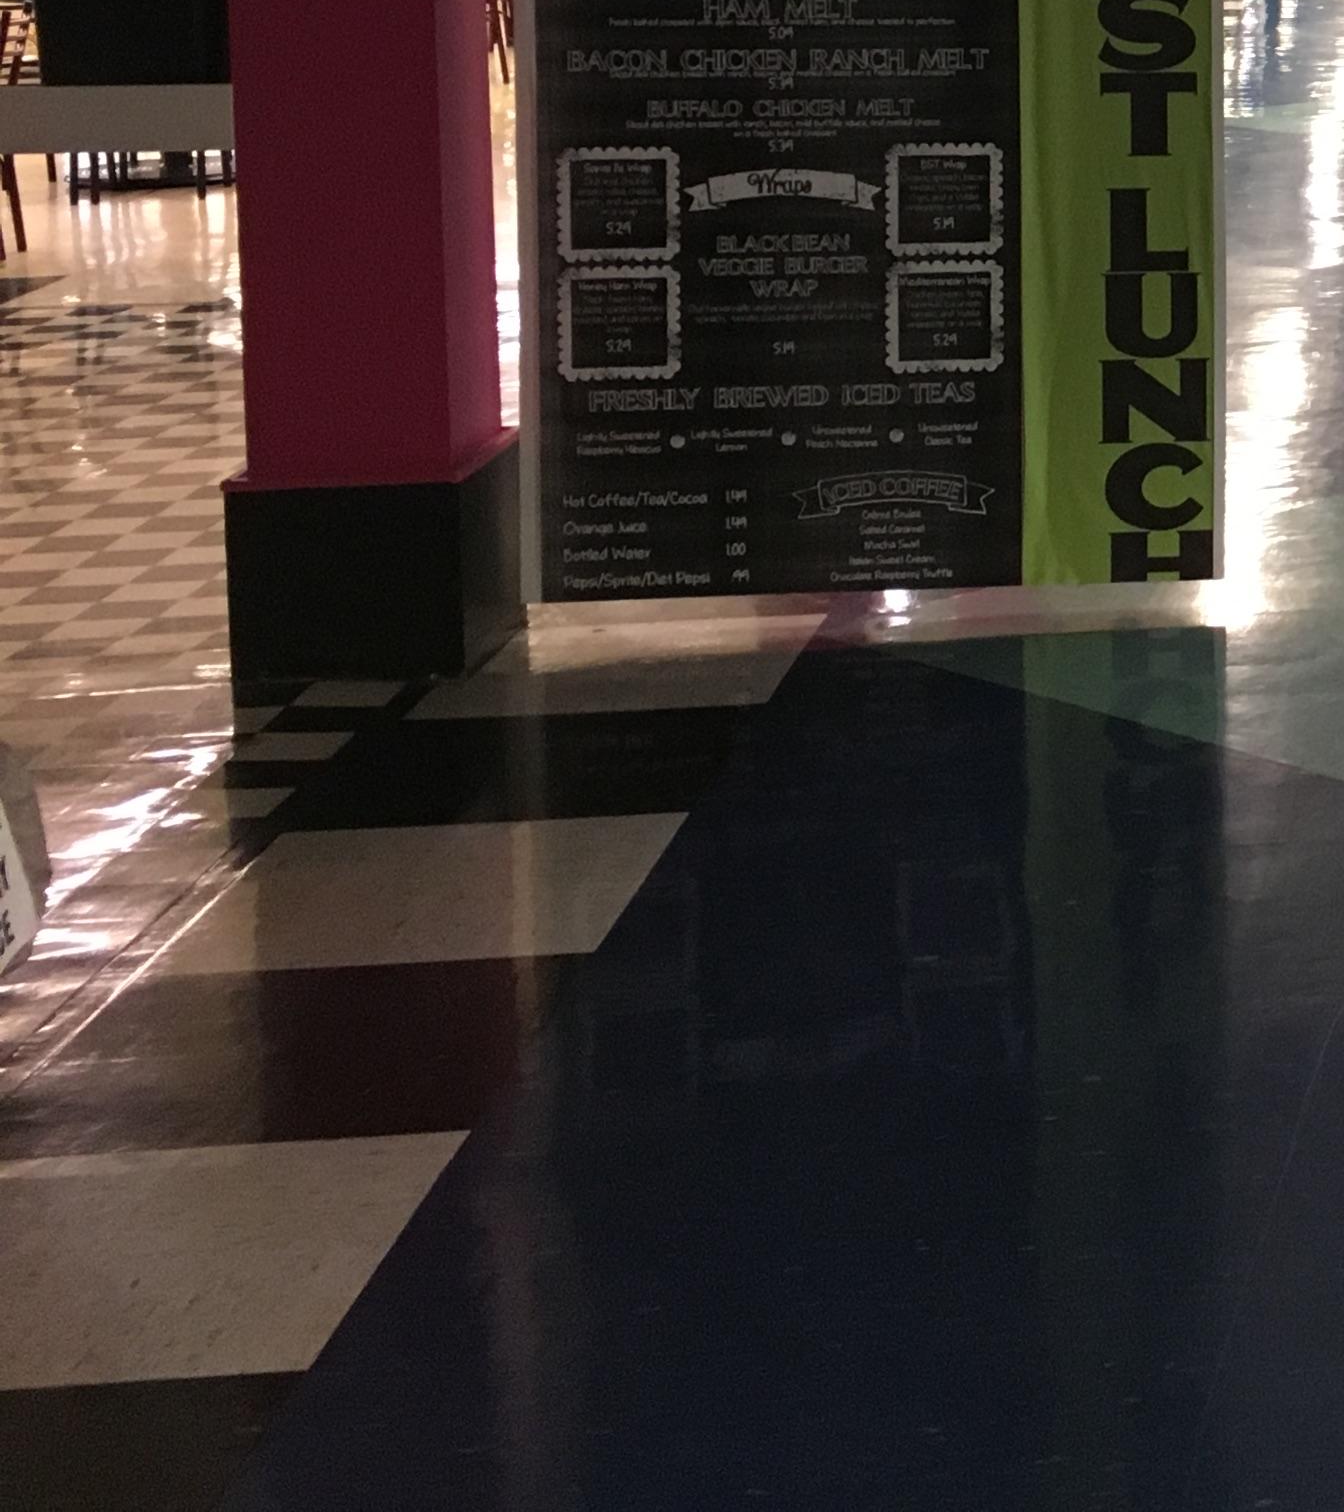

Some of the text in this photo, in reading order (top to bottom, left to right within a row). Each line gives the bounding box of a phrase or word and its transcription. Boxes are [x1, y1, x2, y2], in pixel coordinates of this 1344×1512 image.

[566, 48, 990, 72] BACON CHICKEN RANCH MELT
[646, 98, 915, 118] BUFFALO CHICKEN MELT
[716, 233, 850, 253] BLACK BEAN
[698, 256, 869, 276] VEGGIE BURGER
[750, 279, 818, 297] WRAP
[1100, 188, 1213, 583] LUNCH
[588, 381, 976, 412] FRESHLY BREWED ICED TEAS
[563, 494, 585, 507] Hot
[588, 490, 708, 508] Coffee/Tea/Cocoa
[823, 477, 963, 505] ICED COFFEE
[563, 521, 614, 537] Orange
[611, 545, 651, 560] Water
[675, 571, 711, 586] Pepsi
